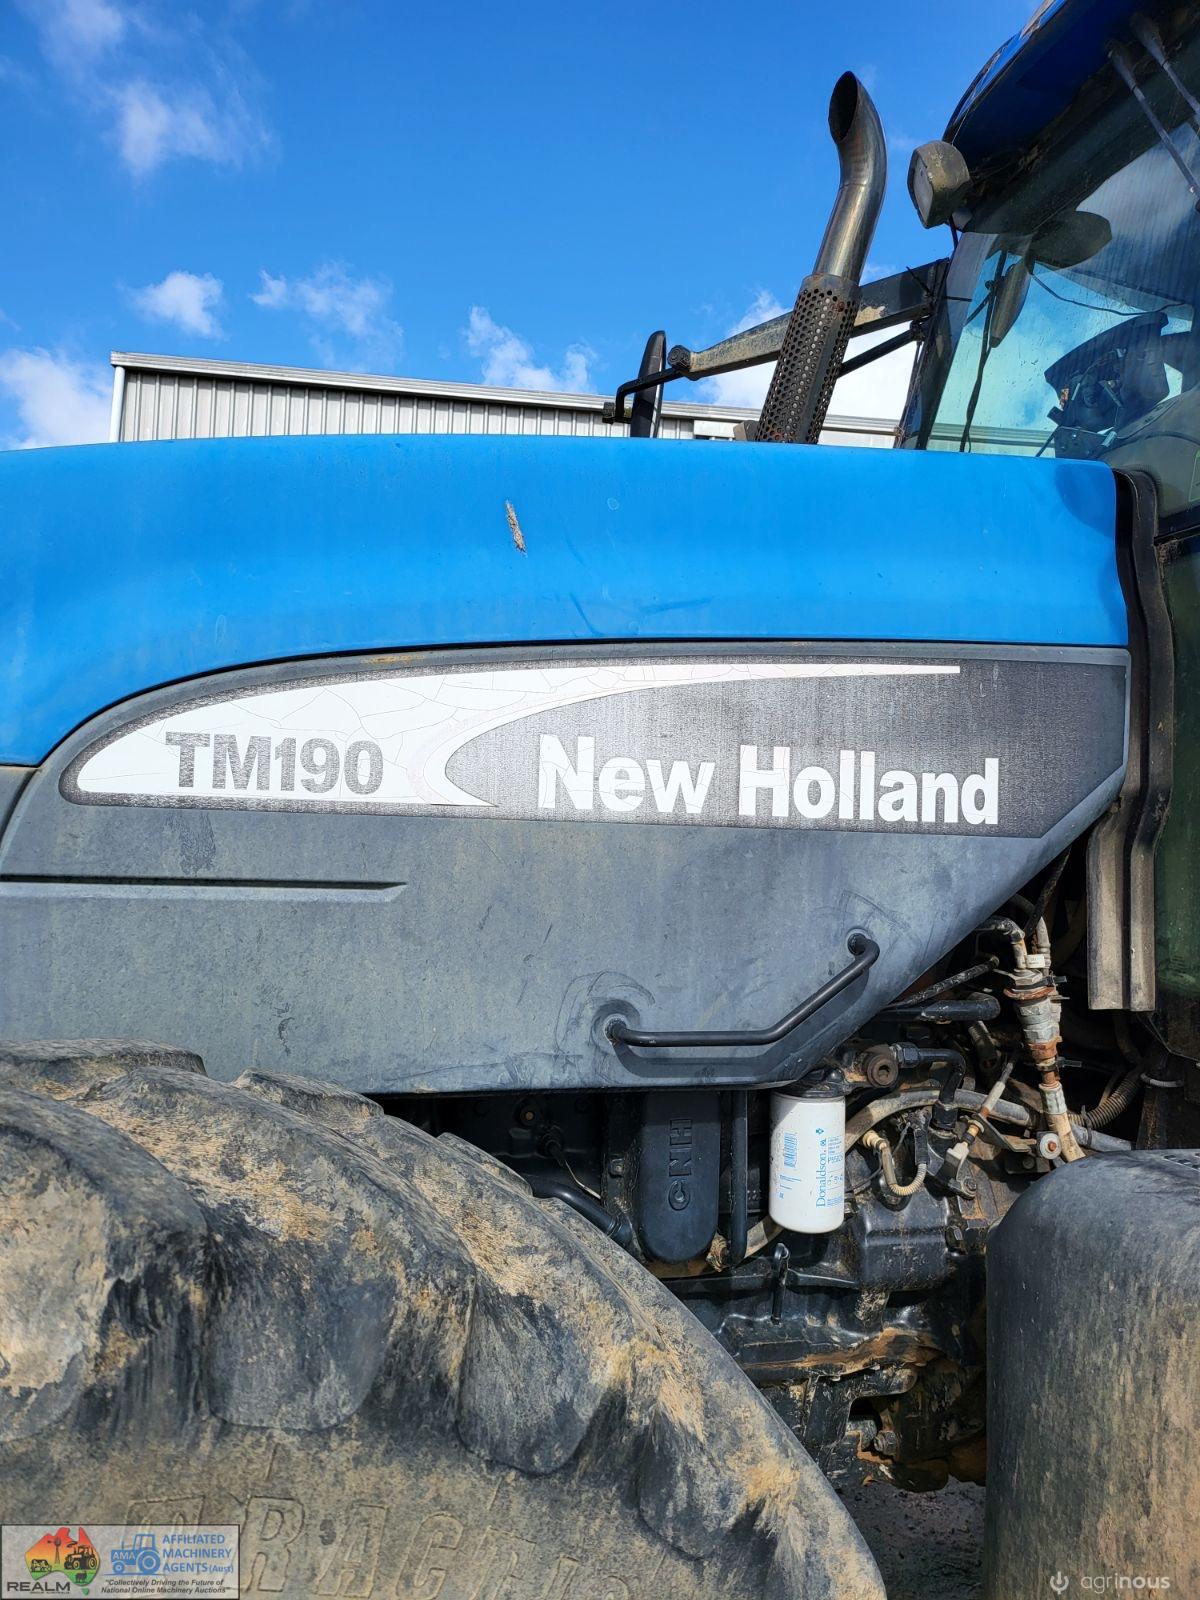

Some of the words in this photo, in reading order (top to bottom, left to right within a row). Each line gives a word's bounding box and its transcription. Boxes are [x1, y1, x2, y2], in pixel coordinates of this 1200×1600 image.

[165, 731, 384, 795] TM190
[537, 733, 716, 814] New
[738, 744, 1000, 825] Holland
[668, 1118, 694, 1211] CNH
